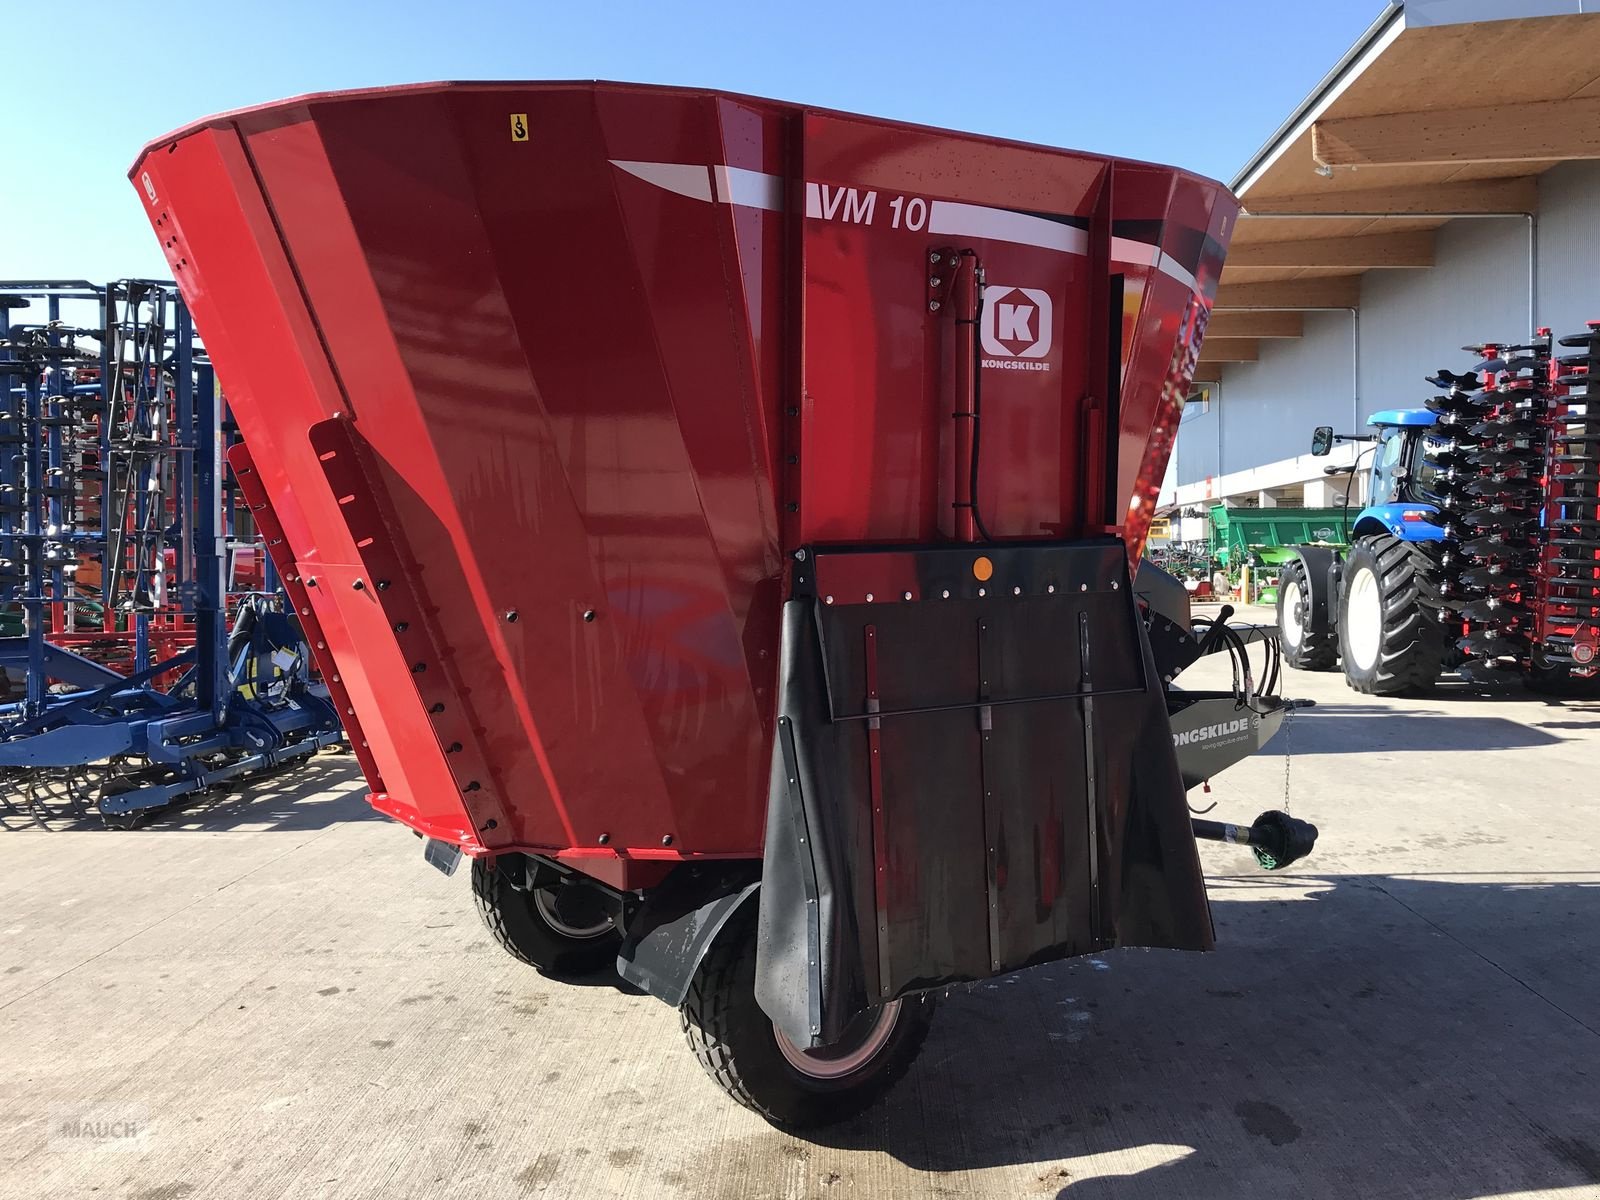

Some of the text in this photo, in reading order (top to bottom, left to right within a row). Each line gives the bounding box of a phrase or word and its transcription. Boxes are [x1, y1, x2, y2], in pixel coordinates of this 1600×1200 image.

[821, 184, 927, 231] VM 10
[981, 359, 1050, 371] KONGSKILDE
[1172, 717, 1249, 747] ONGSKILDE
